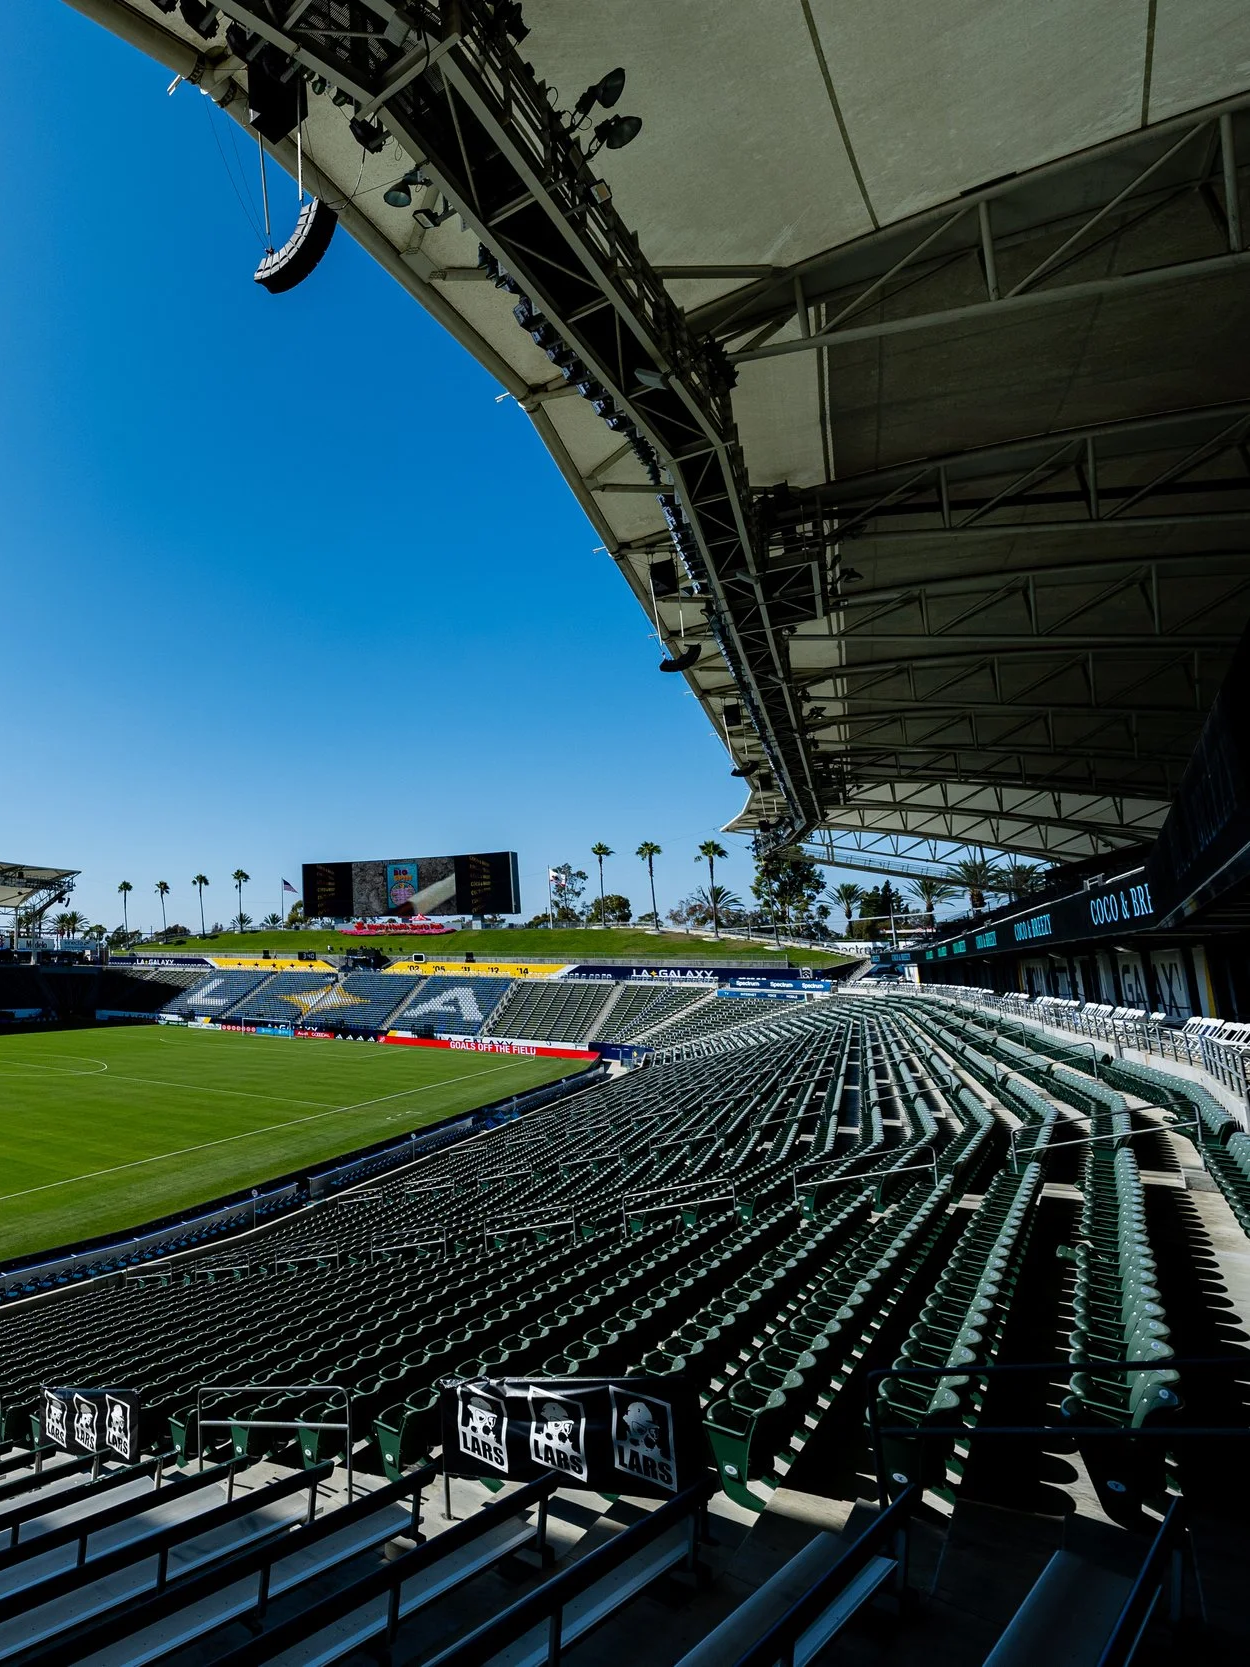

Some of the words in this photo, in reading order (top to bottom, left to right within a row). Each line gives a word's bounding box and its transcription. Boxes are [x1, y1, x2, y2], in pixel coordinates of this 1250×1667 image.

[1090, 893, 1119, 926] COCO
[1119, 890, 1130, 920] &
[1014, 922, 1028, 941] COCO
[1031, 914, 1052, 938] BREEZY
[26, 940, 47, 949] Mdelo
[658, 970, 713, 978] GALAXY
[450, 1041, 476, 1051] GOALS
[478, 1043, 492, 1052] OFF
[495, 1045, 510, 1053] THE
[513, 1046, 536, 1055] FIELD
[48, 1422, 64, 1445] LARS
[77, 1426, 95, 1450] LARS
[108, 1430, 128, 1455] LARS
[462, 1431, 504, 1466] LARS
[534, 1439, 584, 1474] LARS
[618, 1445, 673, 1485] LARS
